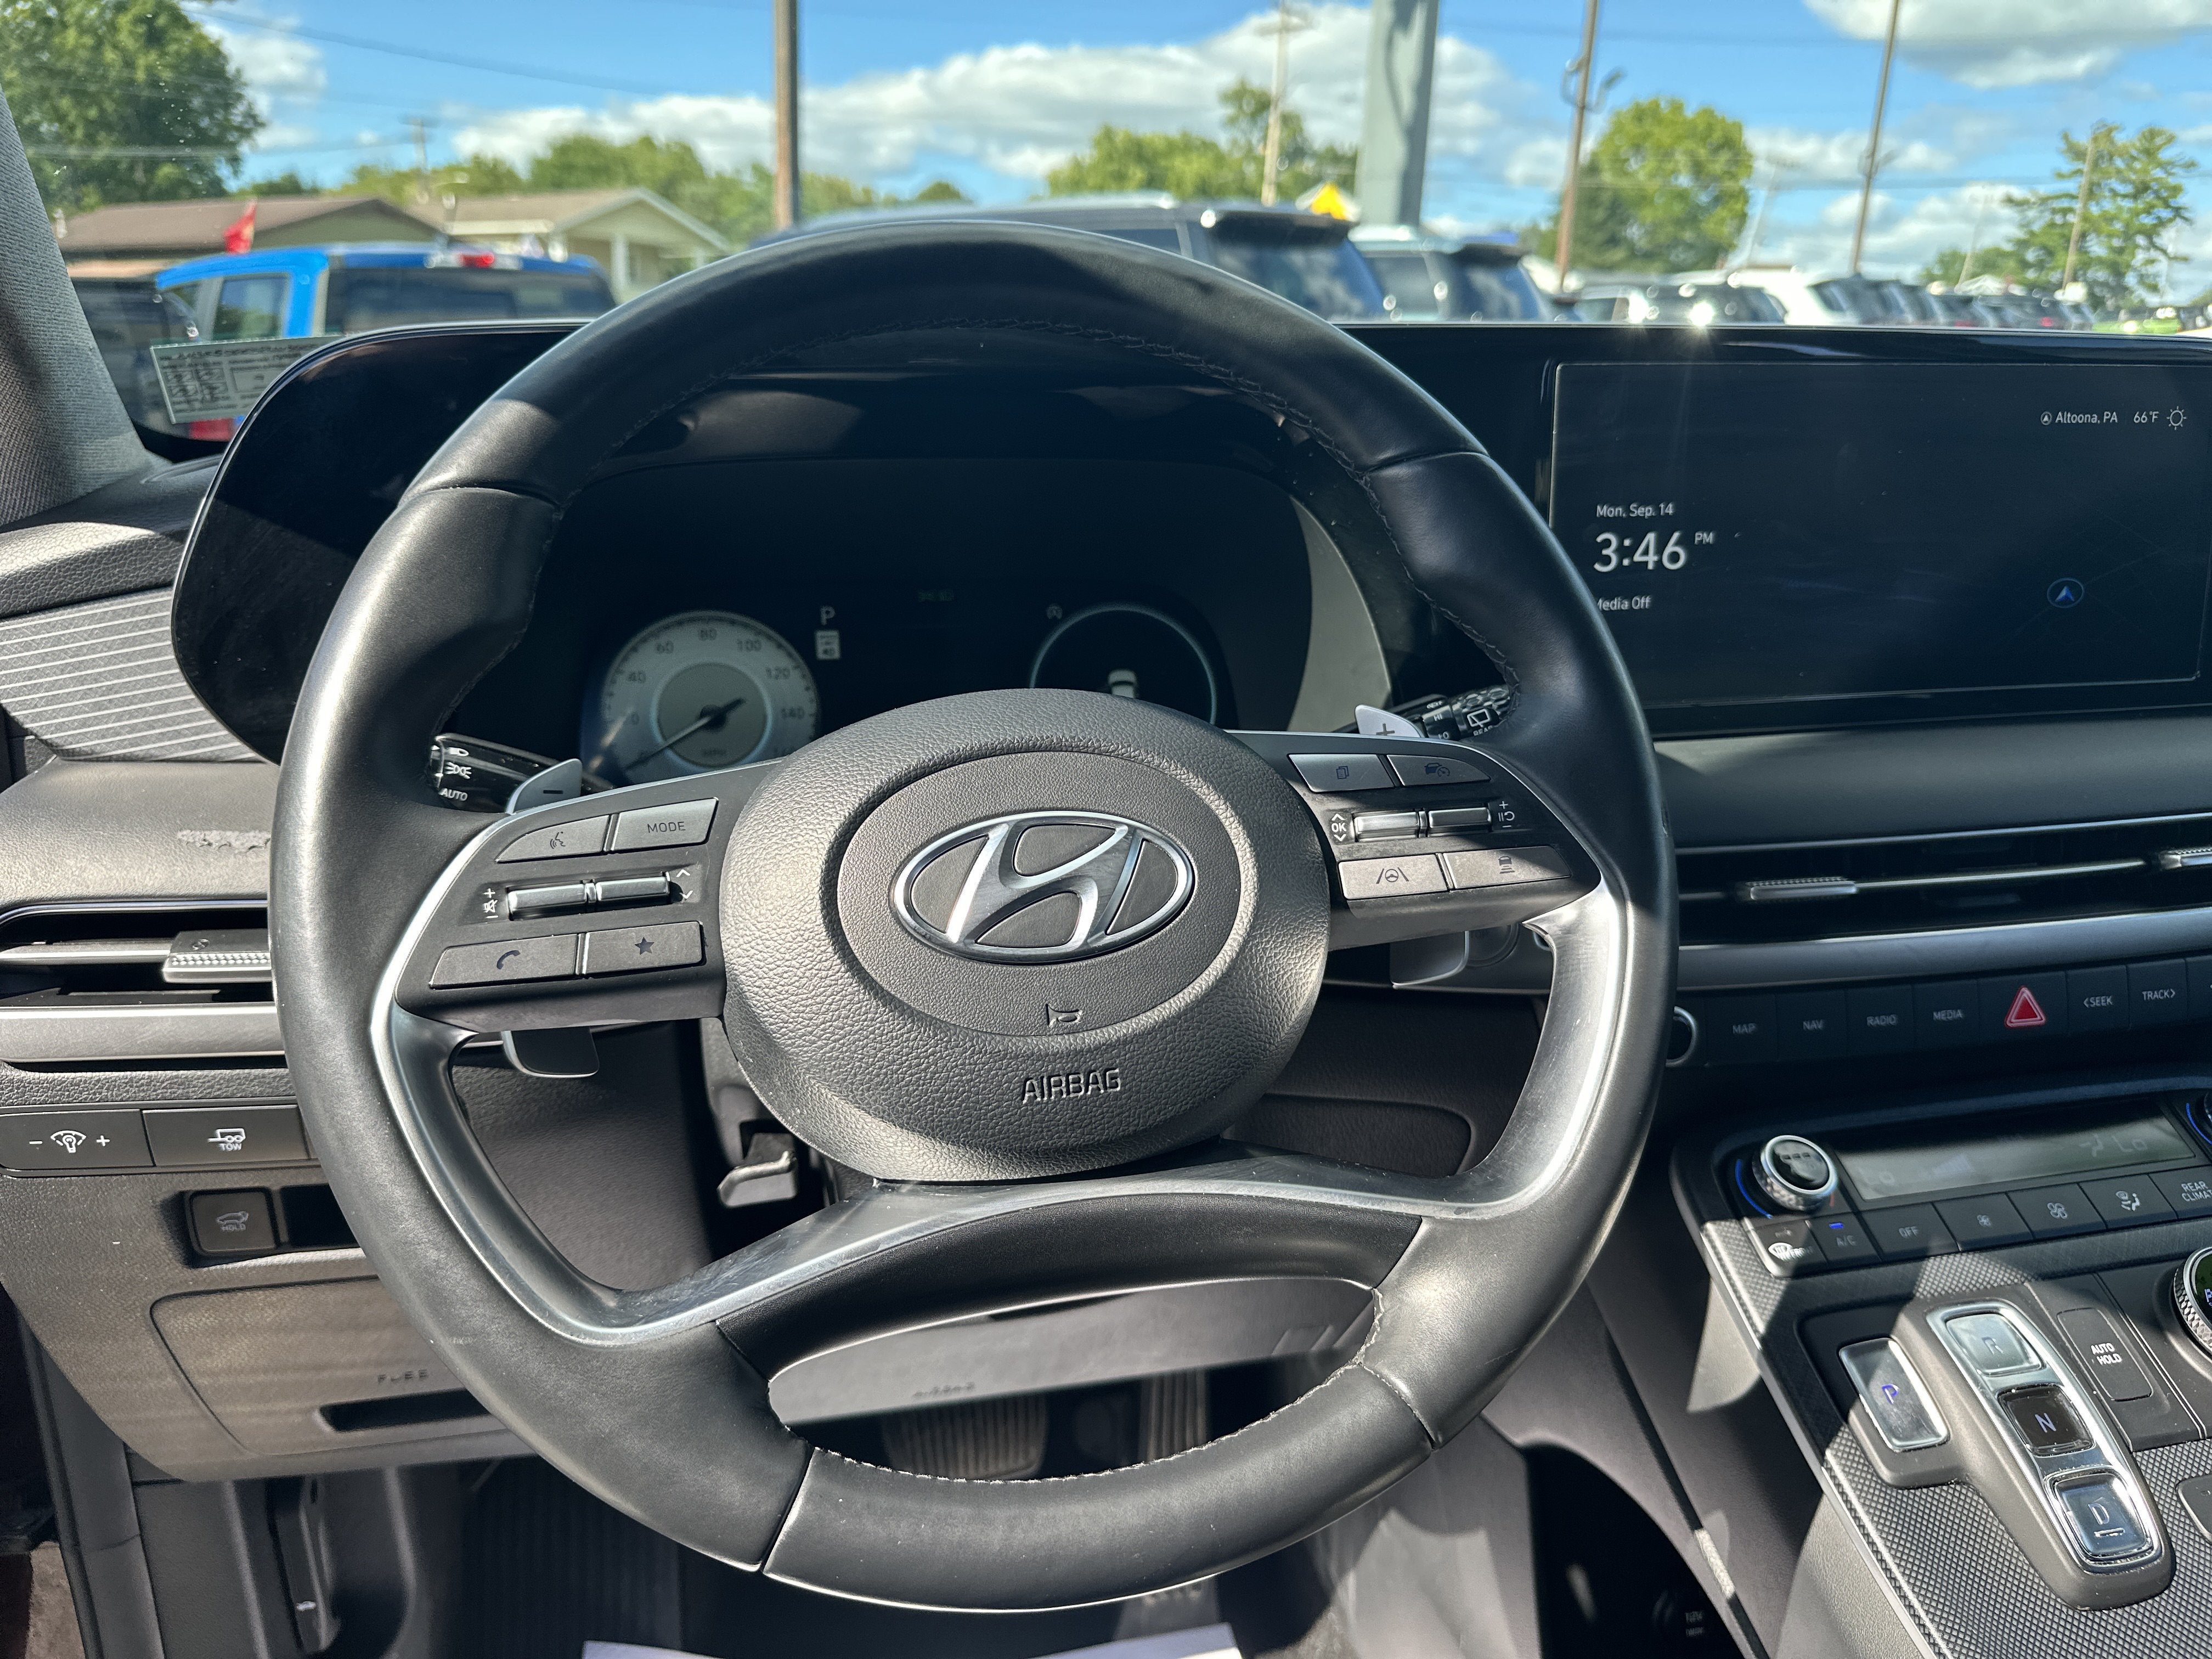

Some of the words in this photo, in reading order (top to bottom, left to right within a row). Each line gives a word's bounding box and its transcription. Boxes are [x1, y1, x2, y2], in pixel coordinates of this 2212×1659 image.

[2055, 411, 2101, 425] Altoona,
[2103, 411, 2119, 424] PA
[1629, 503, 1656, 518] Sep.
[1658, 501, 1674, 516] 14
[1593, 531, 1688, 572] 3:46
[1694, 531, 1715, 545] PM
[1631, 595, 1652, 609] Off
[820, 606, 836, 625] P
[698, 628, 717, 641] 80
[737, 639, 761, 652] 100
[628, 670, 646, 683] 40
[766, 667, 791, 680] 120
[438, 788, 469, 802] AUTO
[647, 821, 686, 833] MODE
[1331, 822, 1347, 833] OK
[1866, 1014, 1898, 1026] RADIO
[1932, 1009, 1963, 1021] MEDIA
[1732, 1023, 1757, 1034] MAP
[1803, 1019, 1824, 1031] NAV
[1022, 1068, 1121, 1104] AIRBAG
[219, 1143, 243, 1152] TOW
[2181, 1181, 2209, 1193] REAR
[221, 1223, 246, 1232] HOLD
[1898, 1226, 1919, 1239] OFF
[1836, 1235, 1857, 1247] A/C
[1982, 1336, 2005, 1355] R
[2091, 1342, 2115, 1356] AUTO
[2096, 1352, 2122, 1365] HOLD
[1881, 1383, 1899, 1404] P
[2034, 1413, 2057, 1432] N
[2087, 1502, 2109, 1525] D
